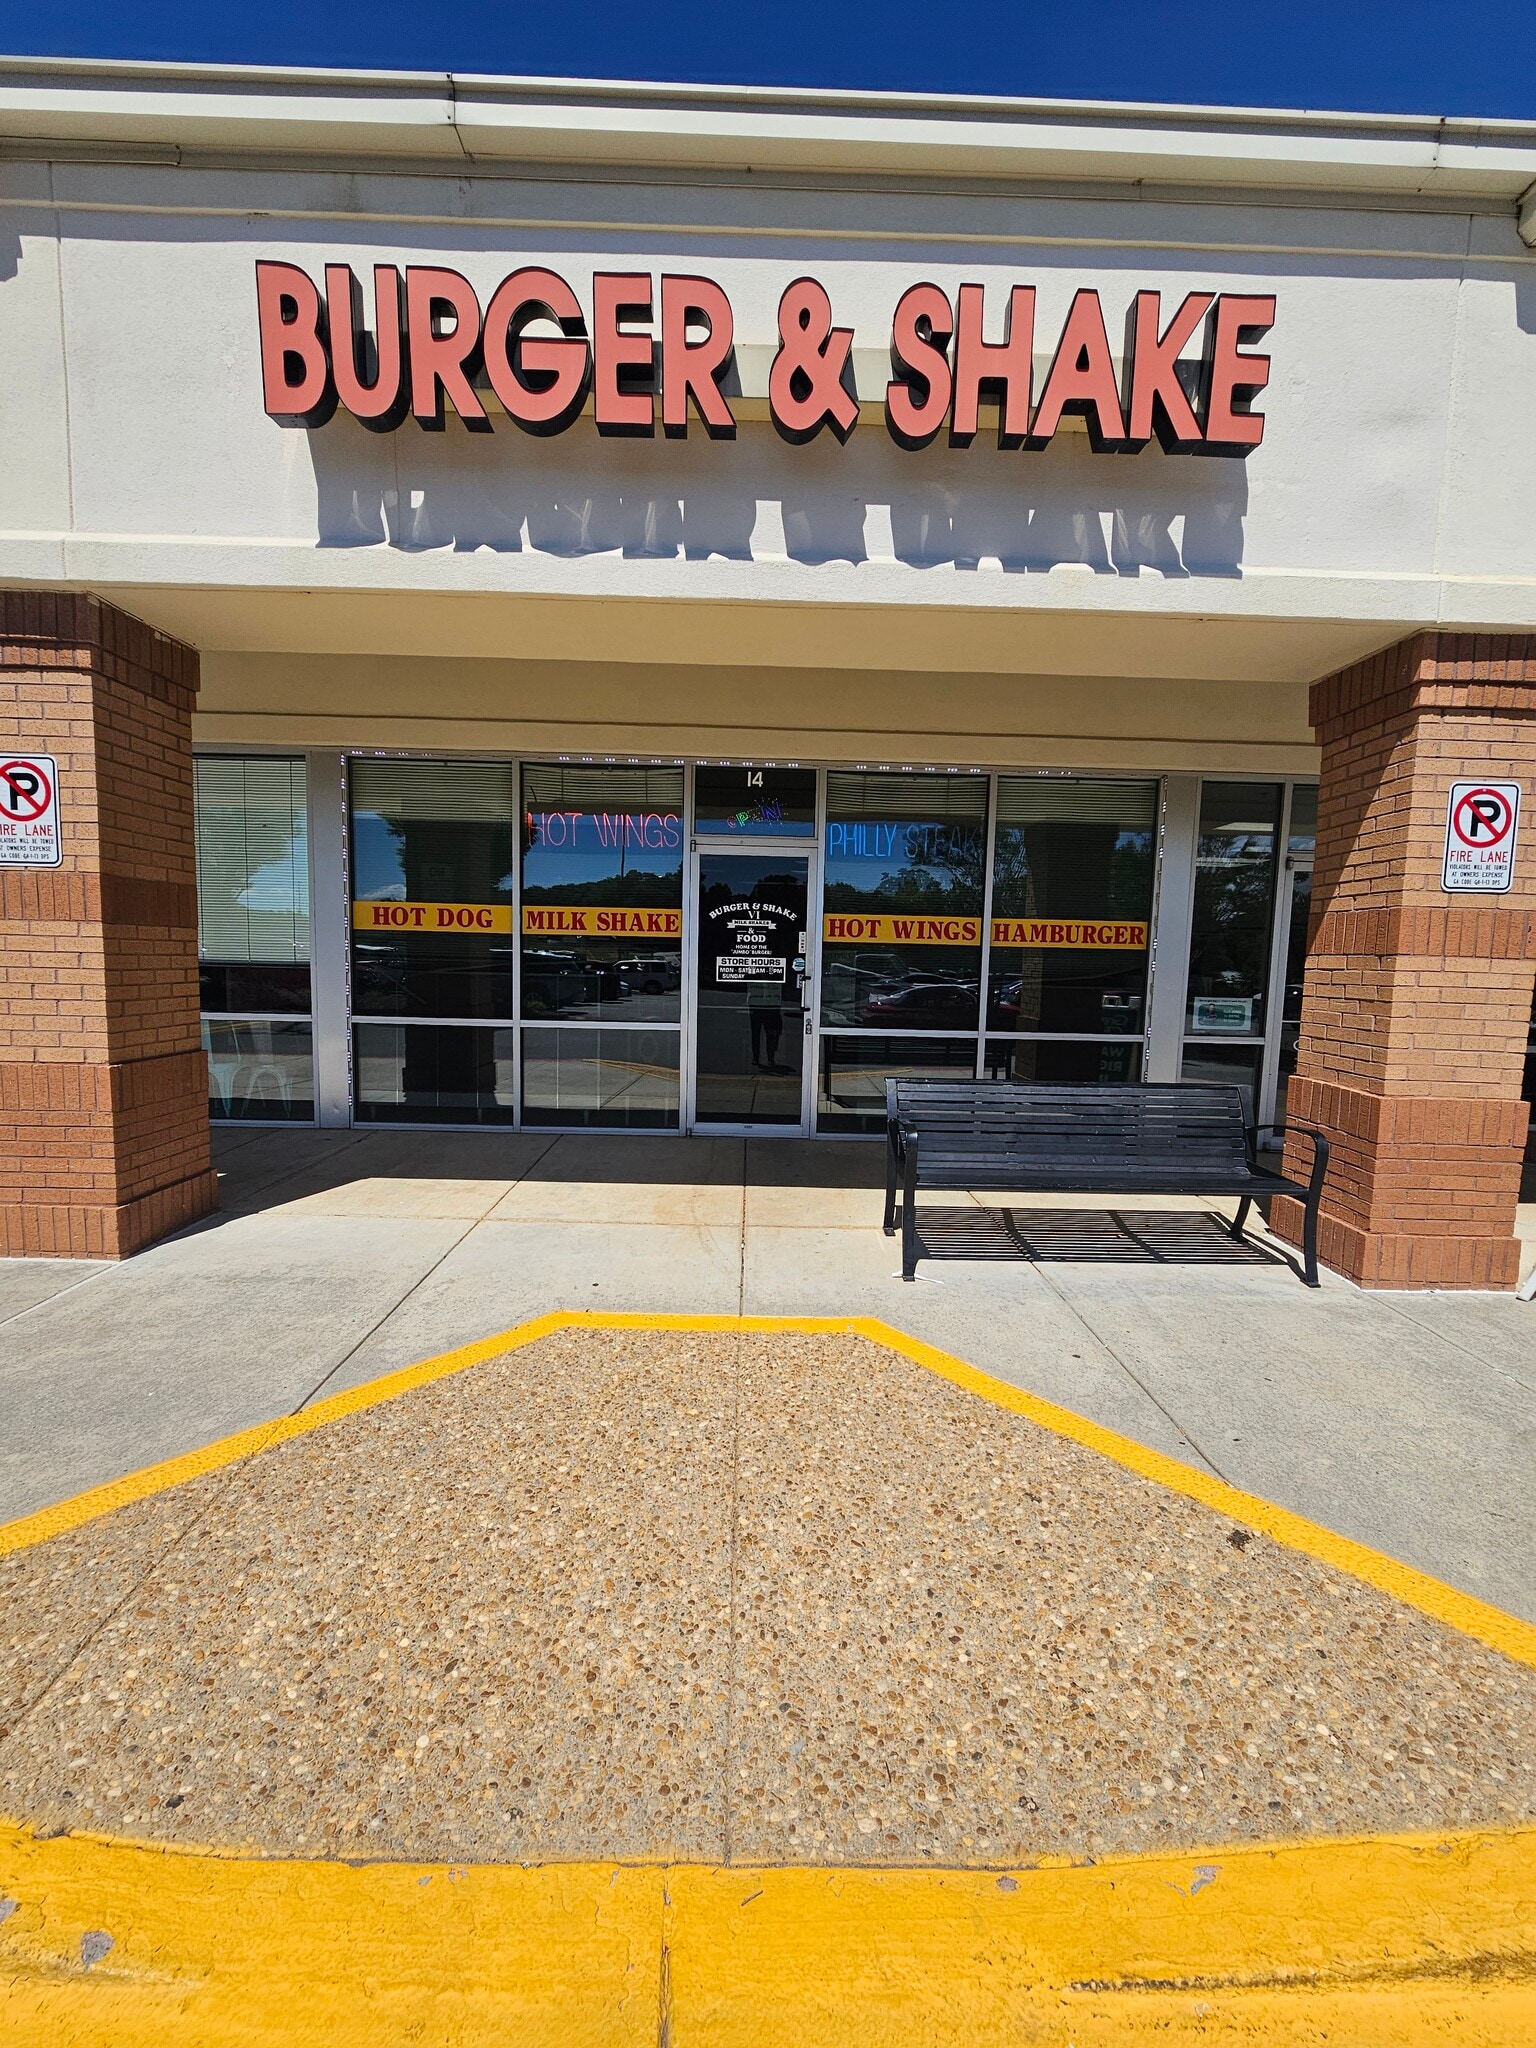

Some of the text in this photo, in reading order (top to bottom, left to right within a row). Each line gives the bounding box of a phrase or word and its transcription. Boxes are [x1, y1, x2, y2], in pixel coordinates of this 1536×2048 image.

[255, 260, 1277, 455] BURGER & SHAKE
[747, 771, 764, 788] 14
[0, 824, 54, 836] IRE LANE
[527, 811, 680, 848] HOT WINGS
[829, 823, 897, 857] PHILLY
[1450, 850, 1509, 863] FIRE LANE
[372, 906, 493, 929] HOT DOG
[709, 902, 798, 921] BURGER & SHAKE
[748, 911, 760, 919] VI
[526, 911, 680, 933] MILK SHAKE
[827, 918, 977, 941] HOT WINGS
[736, 934, 766, 942] FOOD
[993, 923, 1145, 945] HAMBURGER
[751, 958, 781, 966] HOURS
